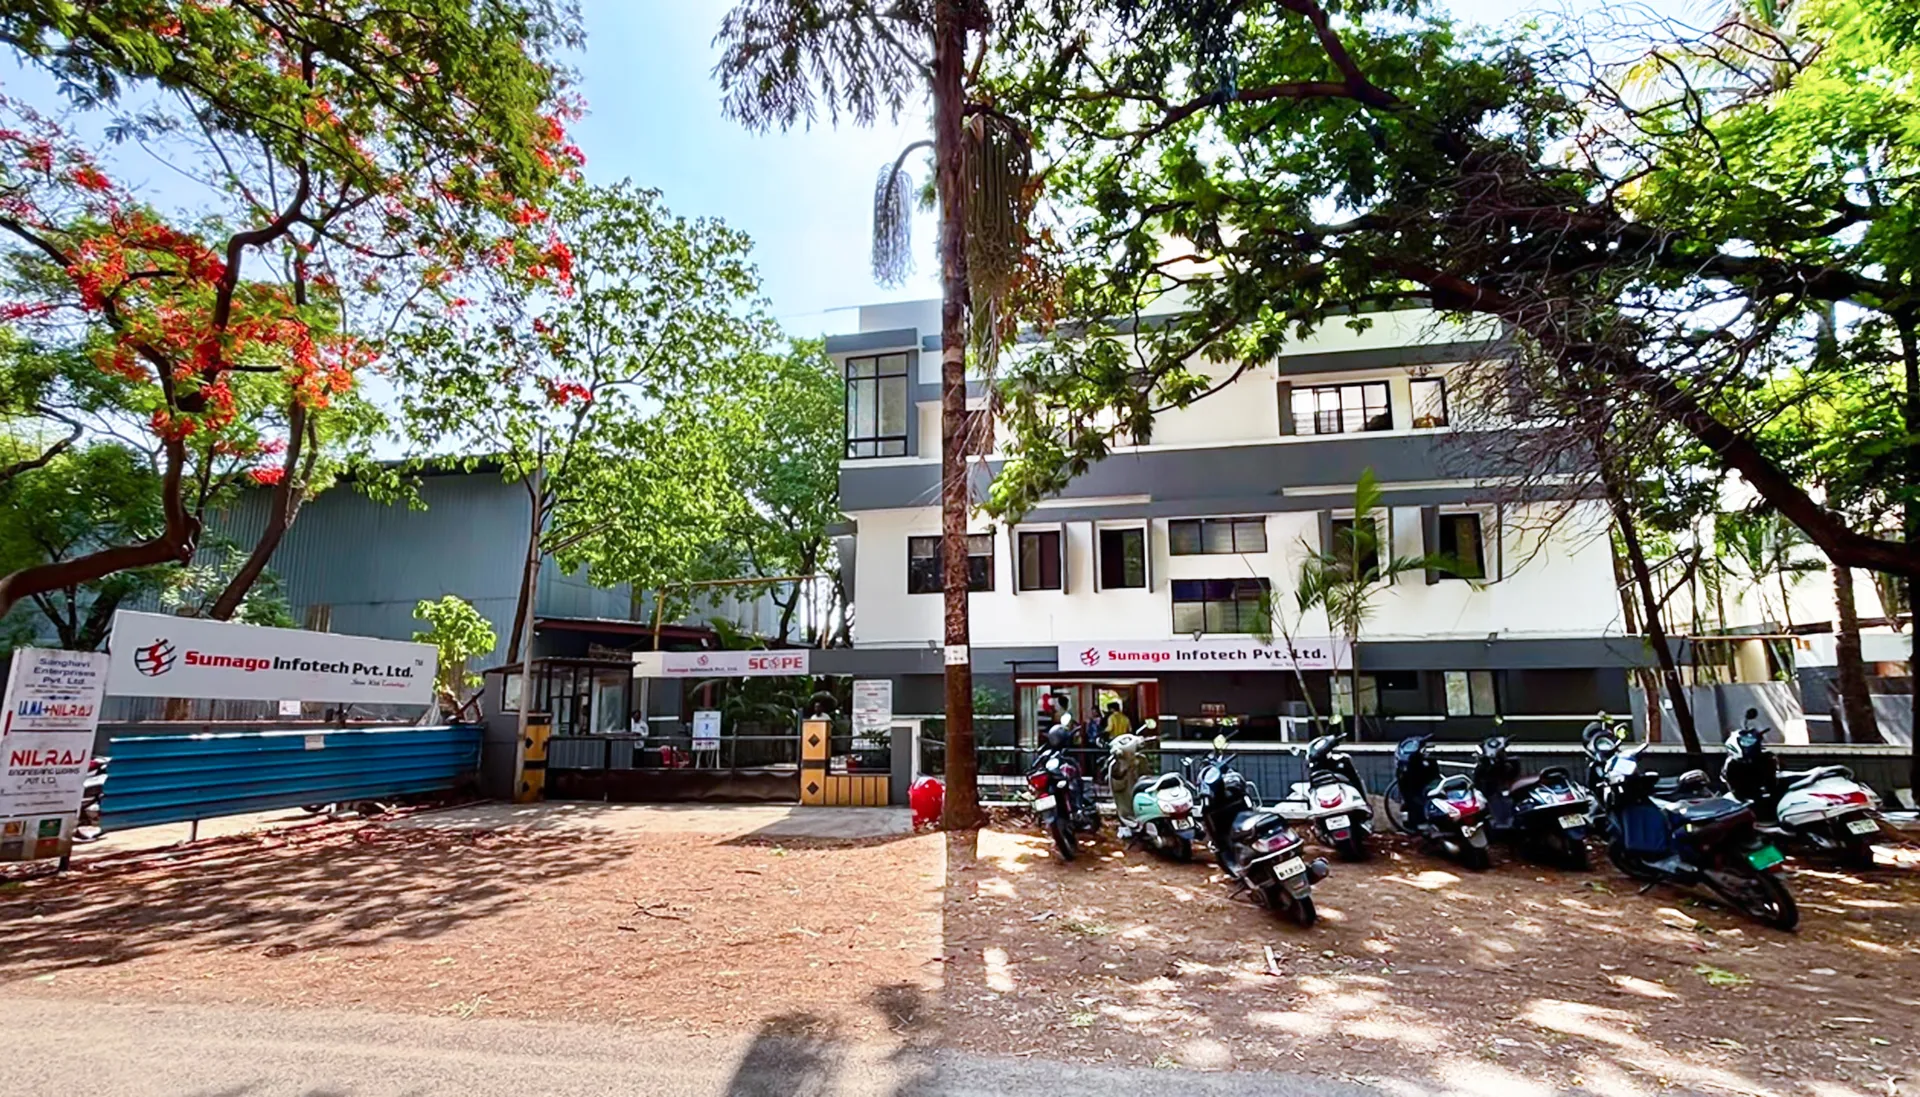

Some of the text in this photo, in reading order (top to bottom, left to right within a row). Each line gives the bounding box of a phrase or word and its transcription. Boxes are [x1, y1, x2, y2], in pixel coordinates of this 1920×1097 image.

[39, 658, 90, 668] Sanghavi
[1108, 648, 1327, 663] Sumago Infotech Pvt. Ltd.
[33, 666, 96, 677] Enterprises
[184, 651, 413, 678] Sumago Infotech Pvt. Ltd.
[9, 749, 86, 767] NILRAJ
